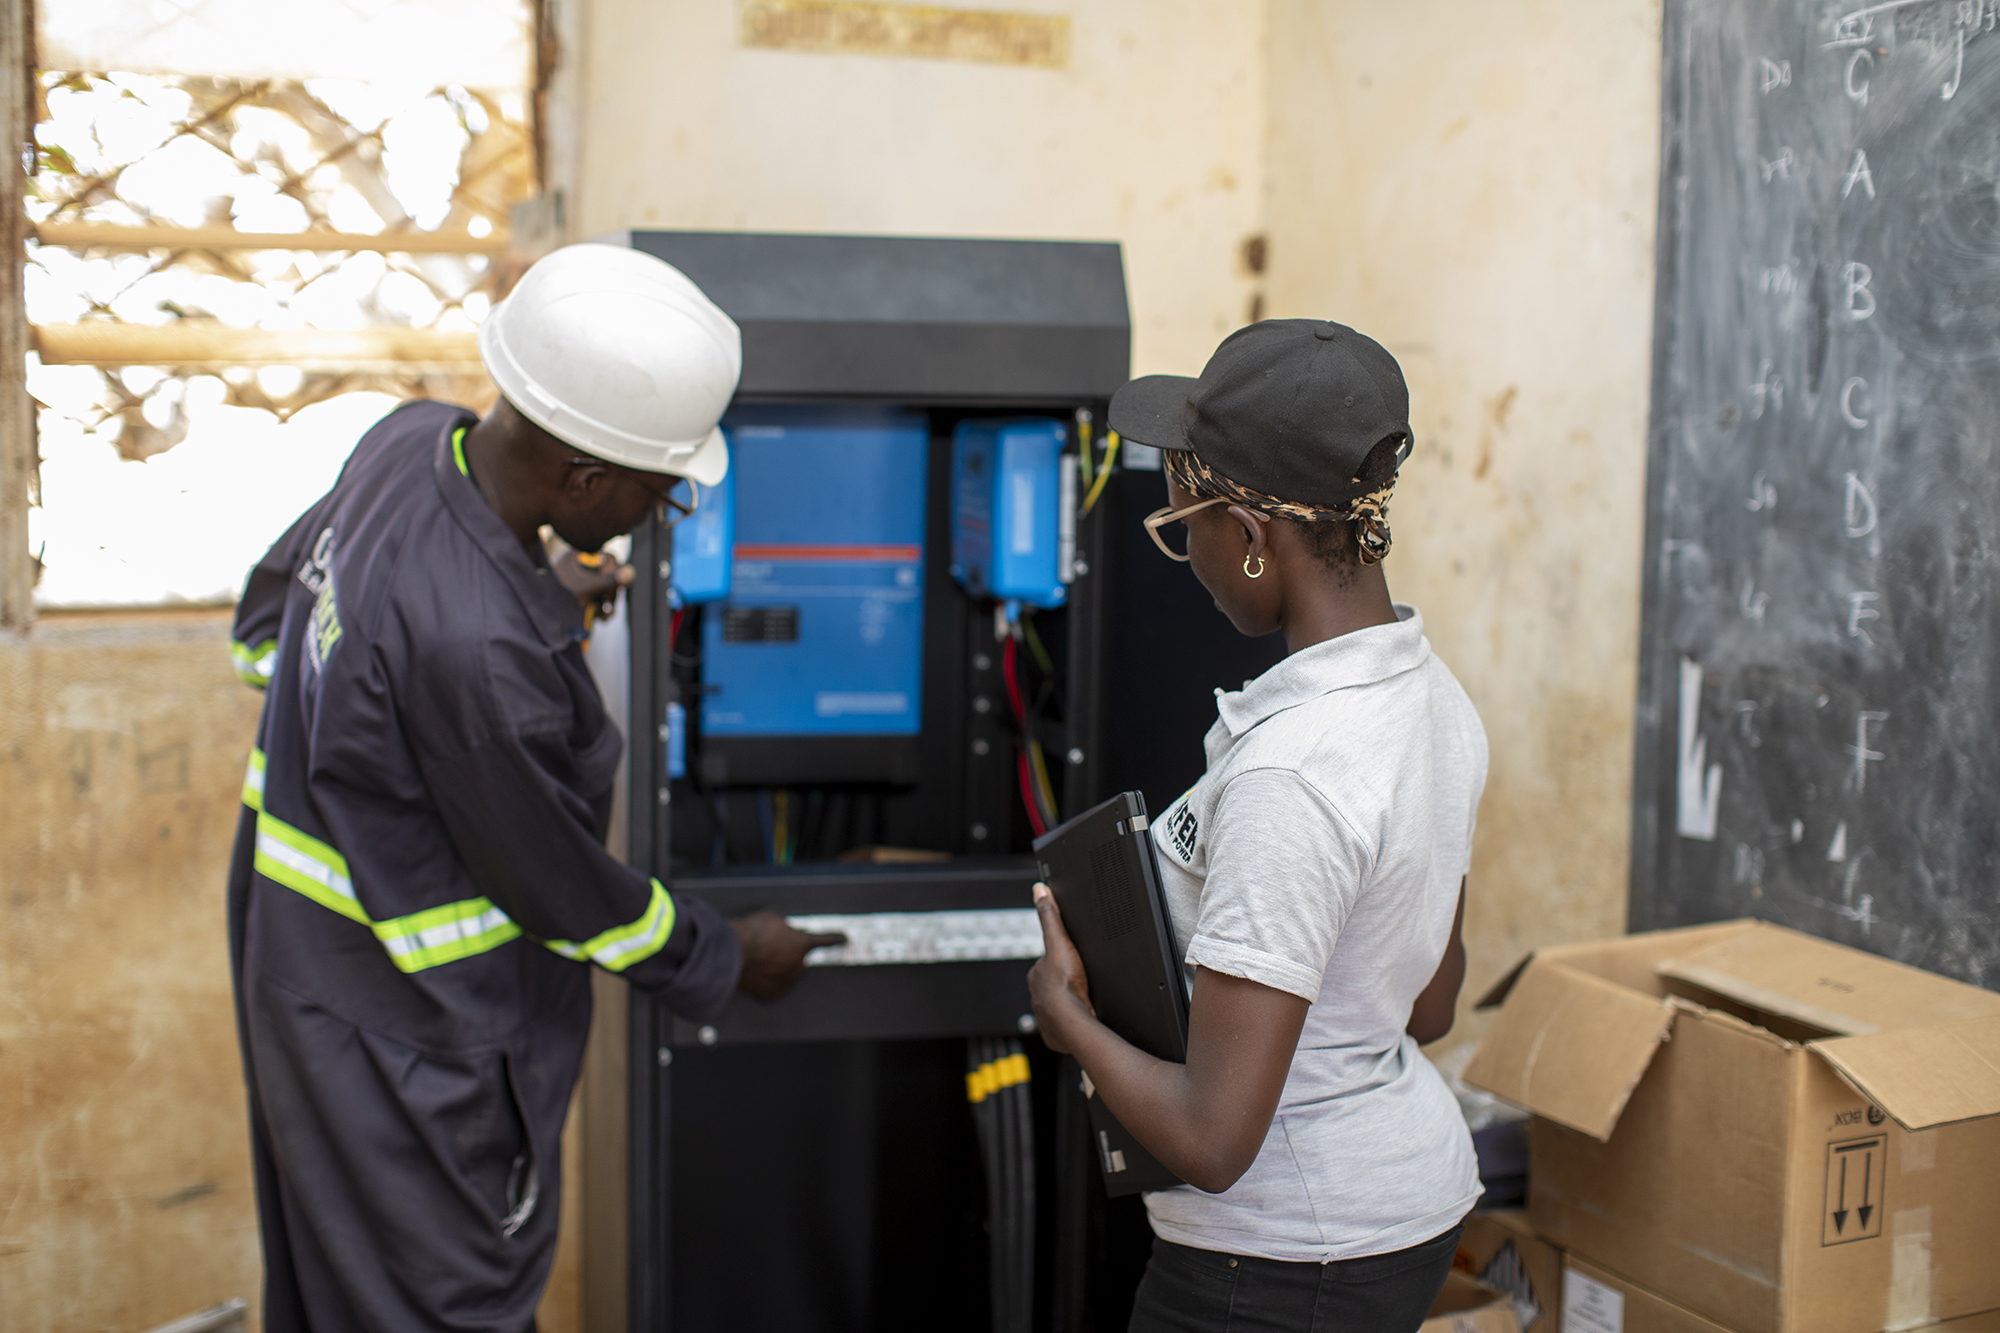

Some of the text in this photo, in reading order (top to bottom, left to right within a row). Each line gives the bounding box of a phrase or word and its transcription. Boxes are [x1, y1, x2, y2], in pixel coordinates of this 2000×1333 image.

[1841, 148, 1876, 200] A
[1843, 261, 1877, 321] B
[1840, 376, 1869, 430] C
[1843, 469, 1878, 538] D
[1846, 710, 1890, 796] F
[1171, 836, 1192, 865] POWER
